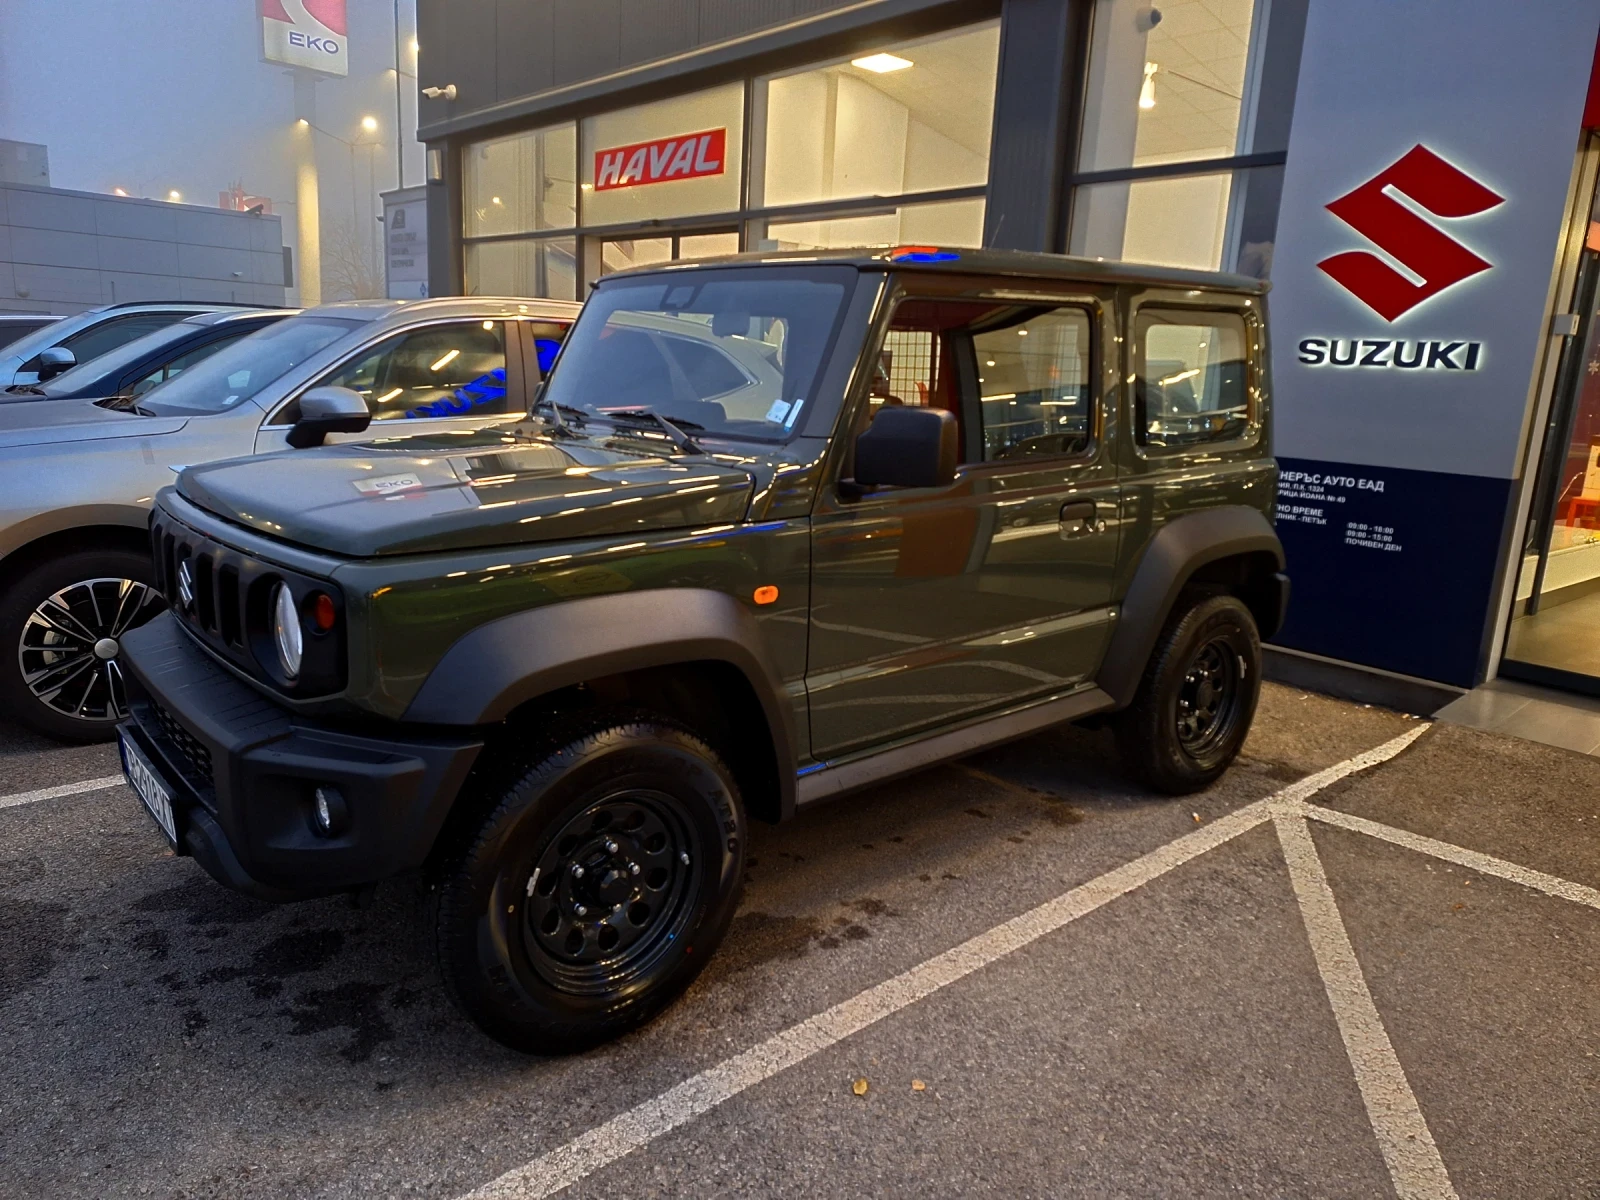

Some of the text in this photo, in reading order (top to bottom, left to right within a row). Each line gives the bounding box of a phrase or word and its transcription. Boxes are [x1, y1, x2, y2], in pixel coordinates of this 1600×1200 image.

[288, 31, 339, 54] EKO
[597, 135, 720, 187] HAVAL
[1298, 339, 1482, 371] SUZUKI
[1279, 470, 1385, 493] НЕРЪС АУТО ЕАД
[1278, 489, 1299, 498] РИЦА
[1292, 505, 1324, 517] ВРЕМЕ
[1302, 515, 1327, 525] ПЕТЪК
[1344, 537, 1402, 552] ПОЧИВЕН ДЕН
